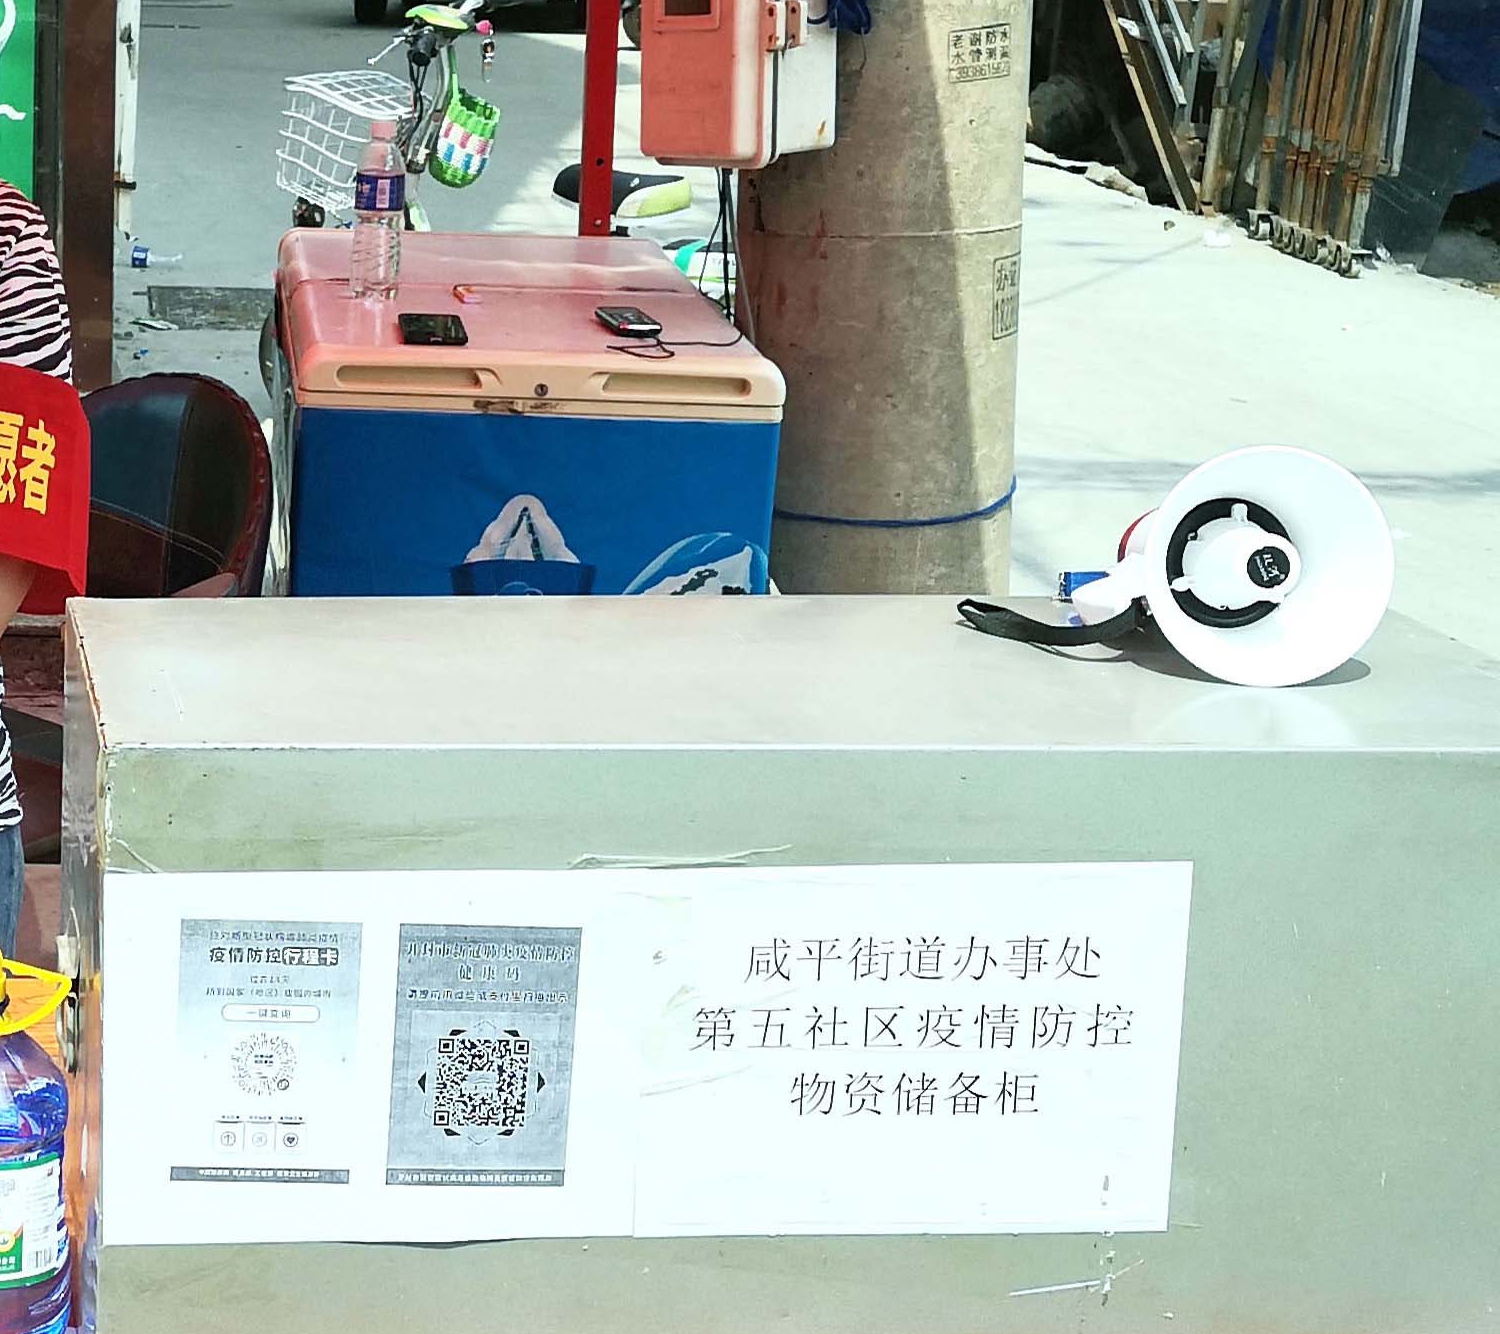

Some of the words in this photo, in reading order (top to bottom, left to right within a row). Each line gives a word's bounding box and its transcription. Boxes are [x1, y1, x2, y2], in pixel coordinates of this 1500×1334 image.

[209, 945, 339, 967] 疫情防控行程卡
[744, 933, 1103, 985] 咸平街道办事处
[693, 1002, 1135, 1055] 第五社区疫情防控
[789, 1069, 1042, 1120] 物资储备柜
